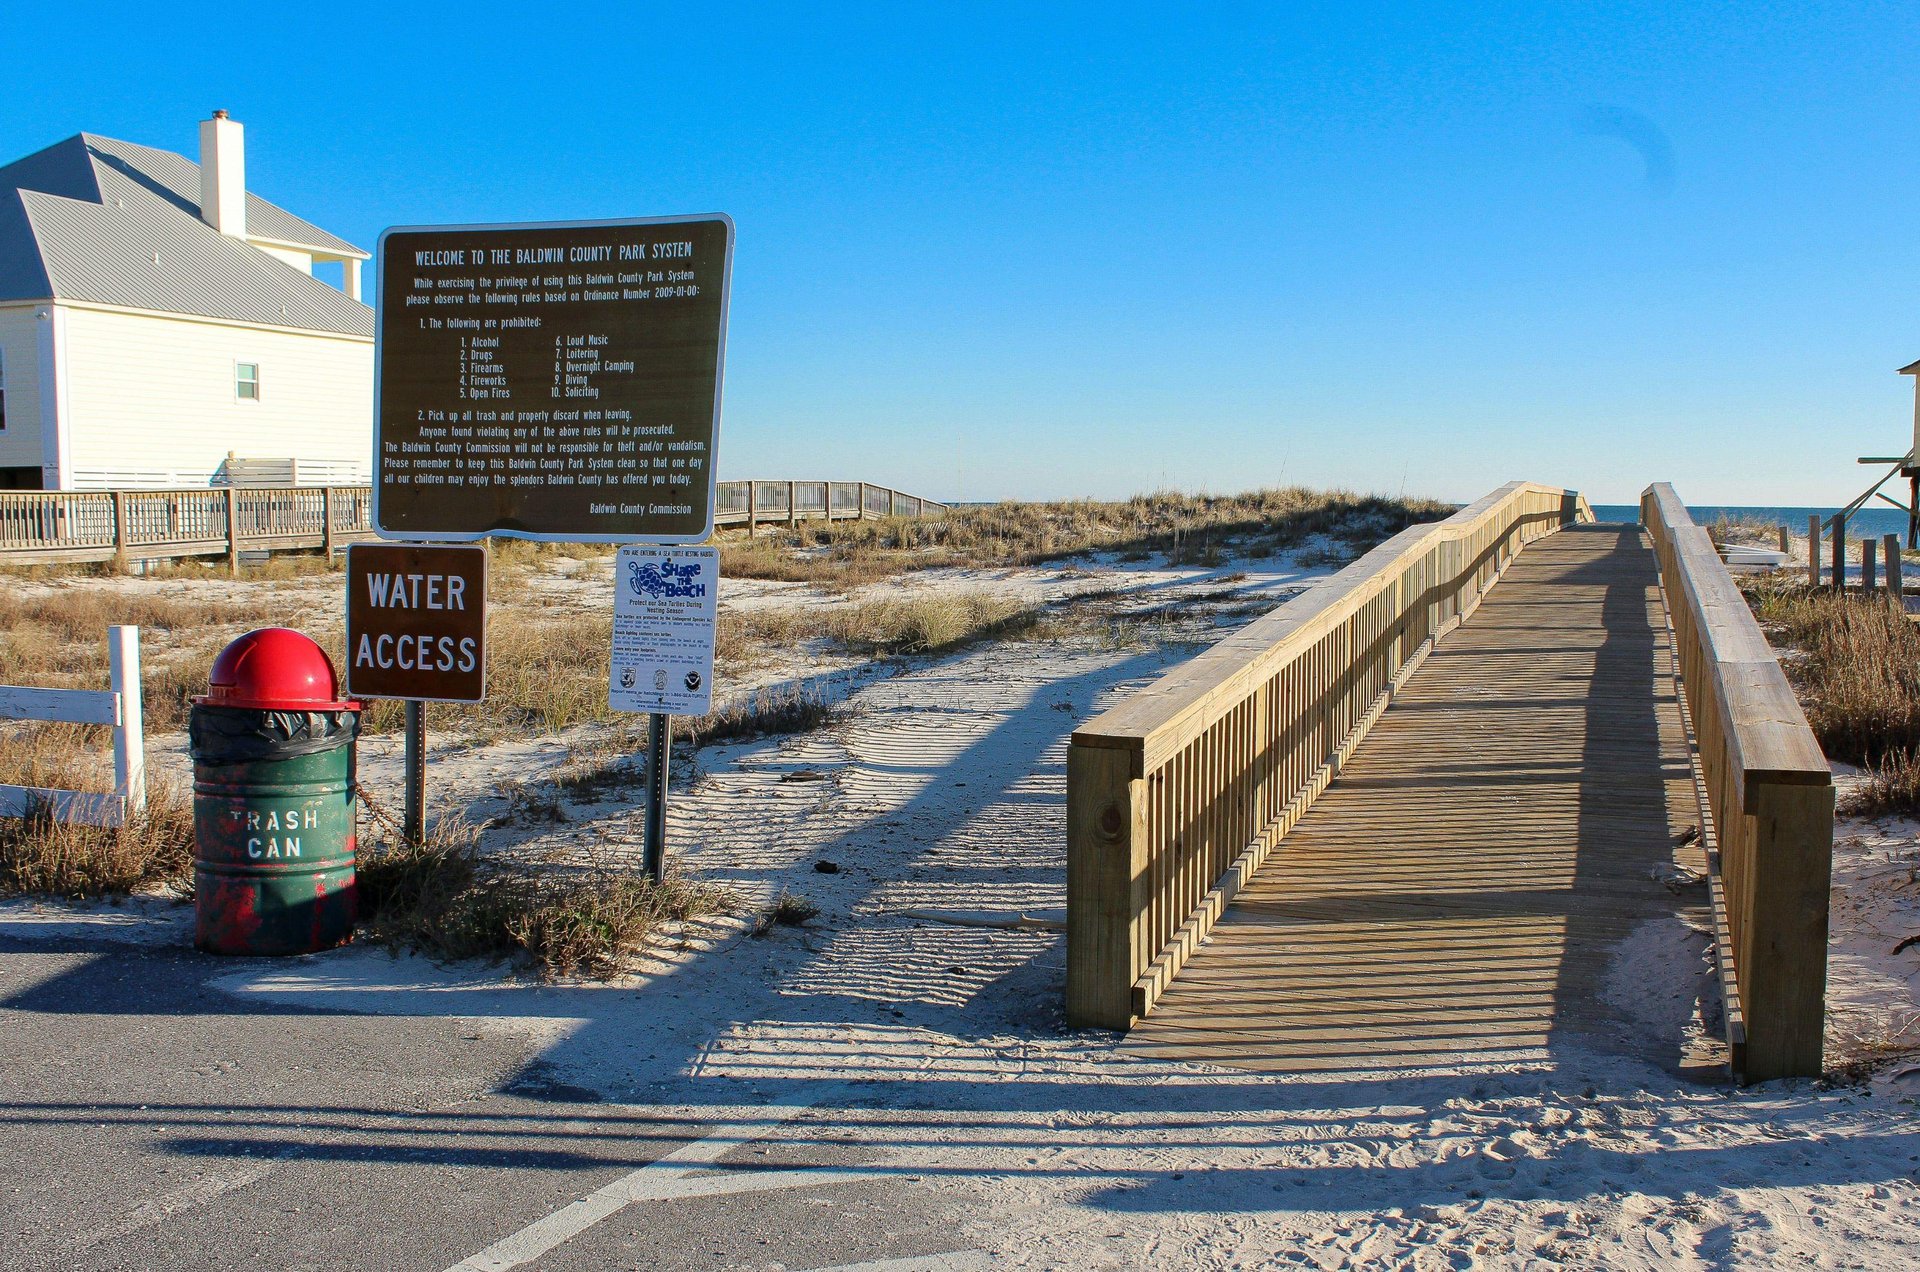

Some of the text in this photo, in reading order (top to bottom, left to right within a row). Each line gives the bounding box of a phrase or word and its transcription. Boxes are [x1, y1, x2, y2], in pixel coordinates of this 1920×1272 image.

[415, 241, 692, 265] WELCOME TO THE BALDWIN COUNTY PARK SYSTEM
[413, 270, 694, 290] While exercising the privilege of using this Baldwin County Park System
[406, 285, 700, 306] please observe the following rules based on Ordinance Number 2009-01-00:
[420, 316, 541, 330] 1. The following are prohibited:
[461, 336, 499, 347] 1. Alcohol
[555, 334, 608, 346] 6. Loud Music
[460, 349, 492, 363] 2. Drugs
[555, 348, 598, 362] 7. Loitering
[460, 362, 503, 373] 3. Firearms
[554, 360, 634, 375] 8. Overnight Camping
[459, 375, 506, 385] 4. Fireworks
[554, 374, 587, 388] 9. Diving
[459, 387, 510, 400] 5. Open Fires
[551, 386, 598, 399] 10. Soliciting
[418, 408, 632, 422] 2. Pick up all trash and properly discard when leaving.
[419, 424, 674, 439] Anyone found violating any of the above rules will be prosecuted.
[384, 440, 706, 454] The Baldwin County Commission will not be responsible for theft and/or vandalism.
[384, 457, 702, 470] Please remember to keep this Baldwin County Park System clean so that one day
[384, 473, 691, 486] all our children may enjoy the splendors Baldwin County has offered you today.
[589, 503, 691, 516] Baldwin County Commission
[367, 573, 465, 610] WATER
[356, 634, 475, 672] ACCESS
[230, 810, 317, 830] TRASH
[248, 838, 300, 858] CAN
